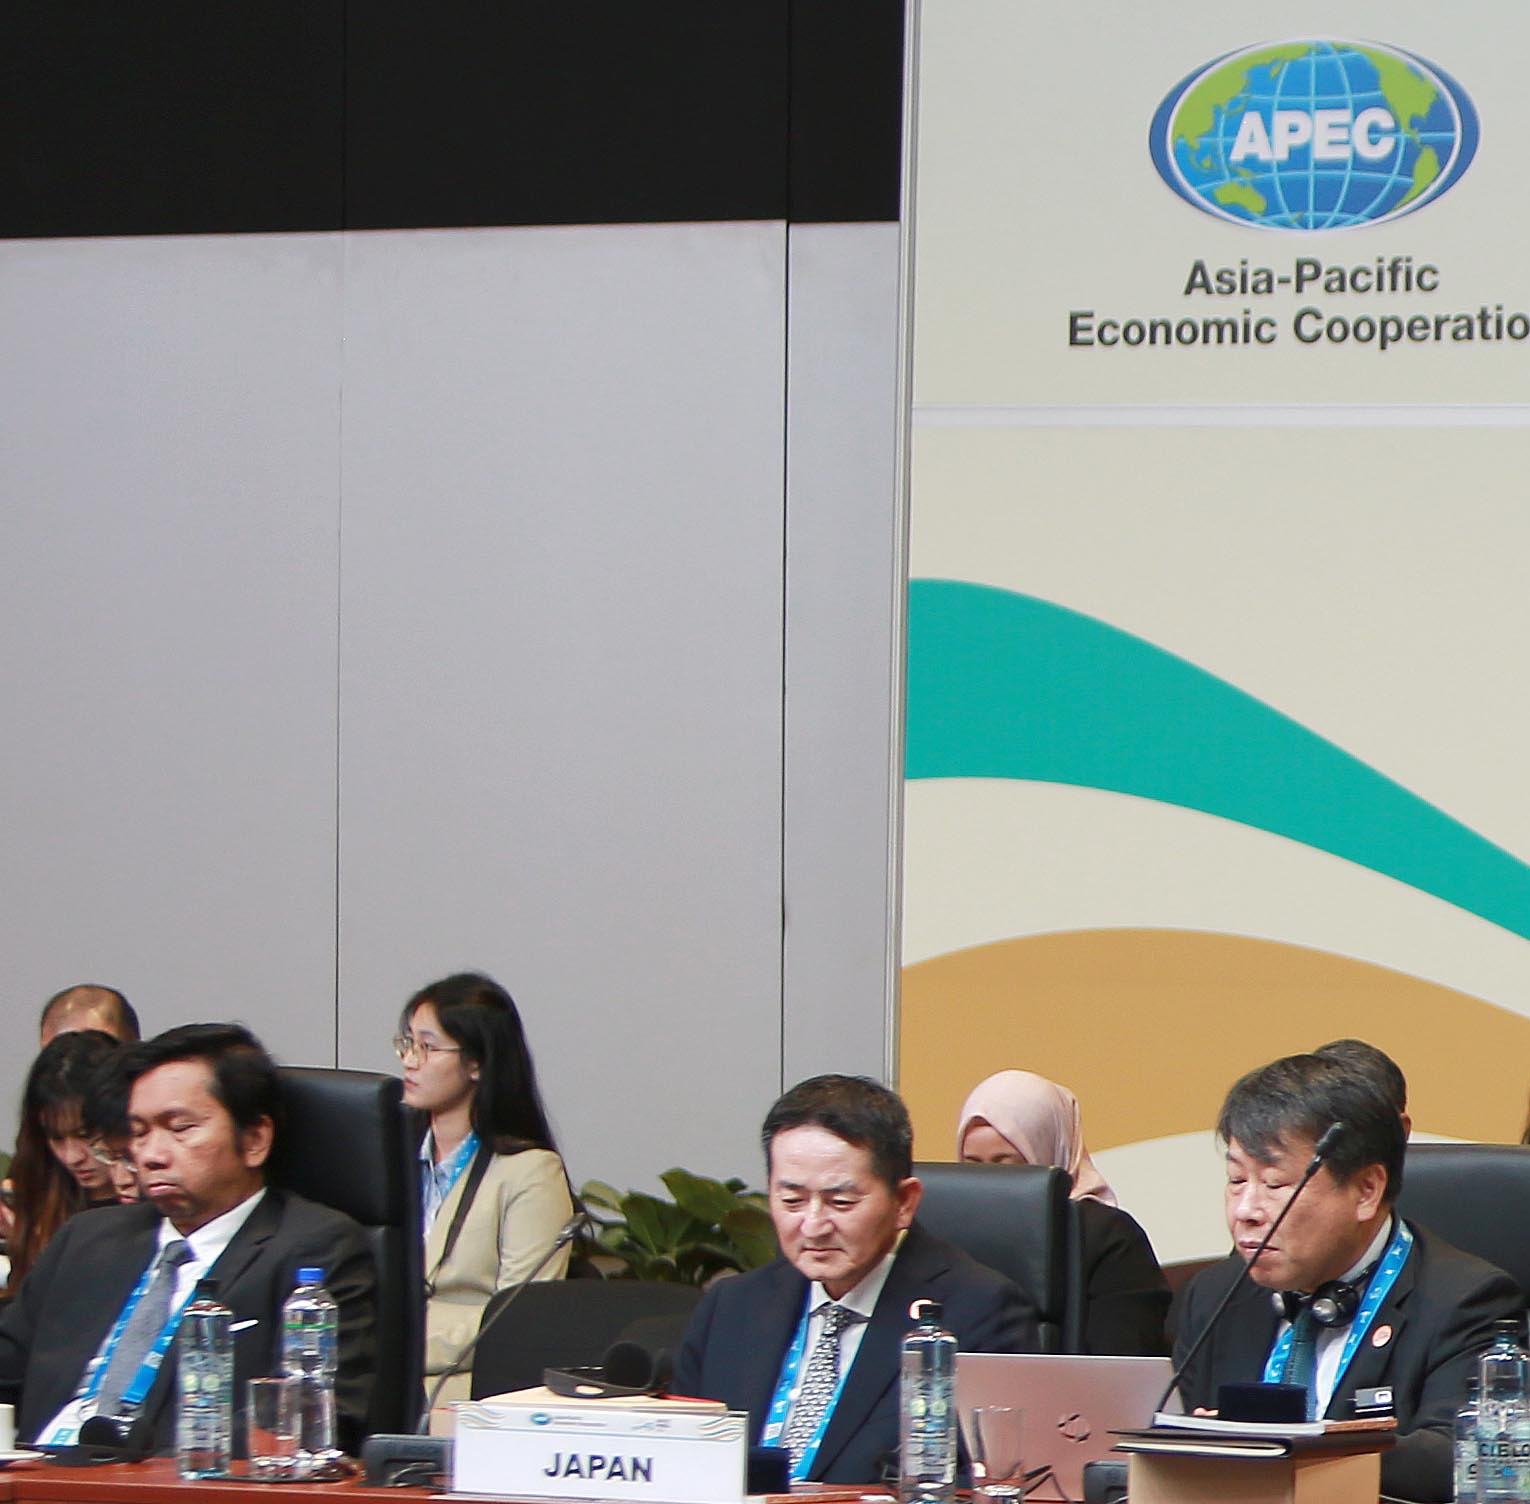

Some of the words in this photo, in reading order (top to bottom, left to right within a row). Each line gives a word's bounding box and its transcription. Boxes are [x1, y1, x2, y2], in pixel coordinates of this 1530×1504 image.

[1229, 107, 1396, 162] APEC
[1183, 255, 1440, 297] Asia-Pacific
[1067, 308, 1278, 347] Economic
[543, 1452, 655, 1483] JAPAN
